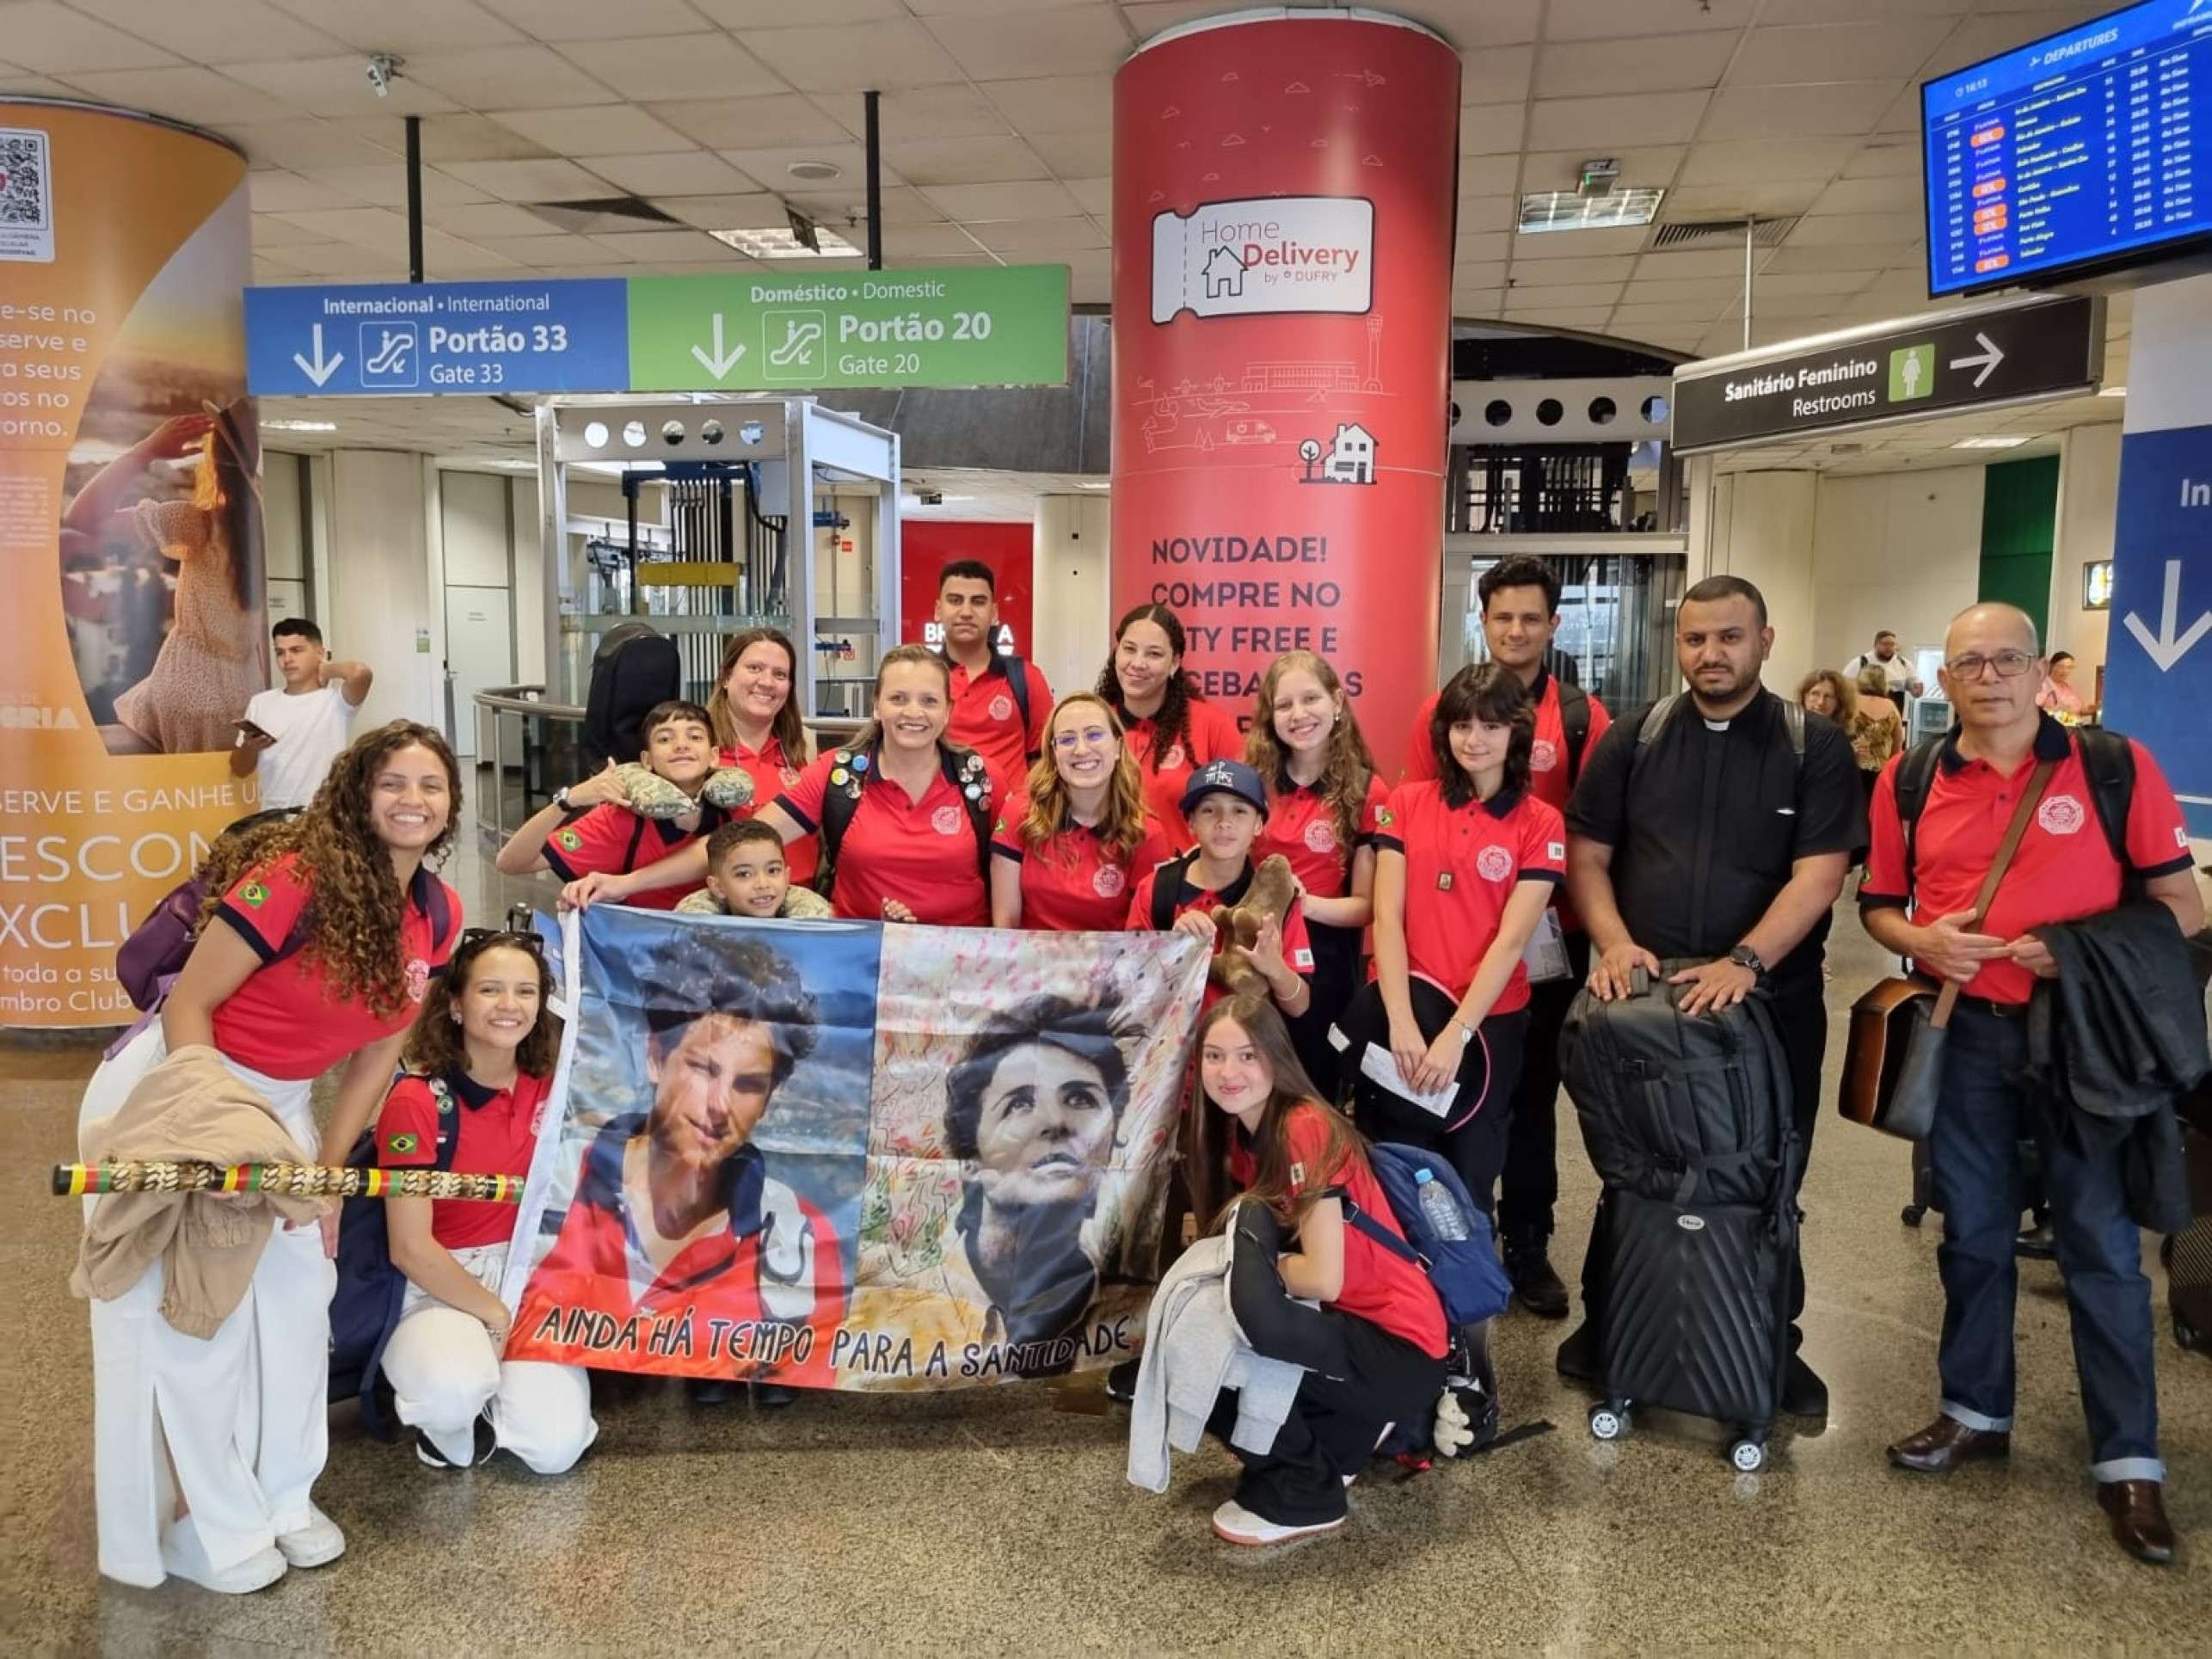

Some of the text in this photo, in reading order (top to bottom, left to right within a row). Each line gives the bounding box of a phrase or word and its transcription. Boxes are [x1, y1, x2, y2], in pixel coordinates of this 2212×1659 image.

[2043, 28, 2119, 65] DEPARTURES
[1203, 220, 1280, 243] Home
[1244, 241, 1359, 273] Delivery
[1264, 271, 1337, 284] by DUFRY
[323, 293, 550, 315] Internacional International
[751, 280, 946, 304] Doméstico Domestic
[64, 309, 96, 323] no
[839, 311, 992, 343] Portão 20
[71, 336, 87, 352] e
[429, 325, 568, 353] Portão 33
[25, 363, 81, 380] seus
[429, 363, 504, 385] Gate 33
[839, 353, 920, 376] Gate 20
[1725, 359, 1877, 402] Sanitário Feminino
[38, 392, 70, 408] no
[1792, 389, 1877, 418] Restrooms
[1152, 536, 1328, 564] NOVIDADE!
[1151, 581, 1341, 608] COMPRE NO
[1186, 626, 1336, 653] TY FREE E
[0, 783, 256, 814] ERVE E GANHE U
[3, 962, 117, 984] toda a su
[69, 989, 132, 1011] Club
[534, 1305, 1132, 1378] AINDA HÁ TEMPO PARA A SANTIDADE
